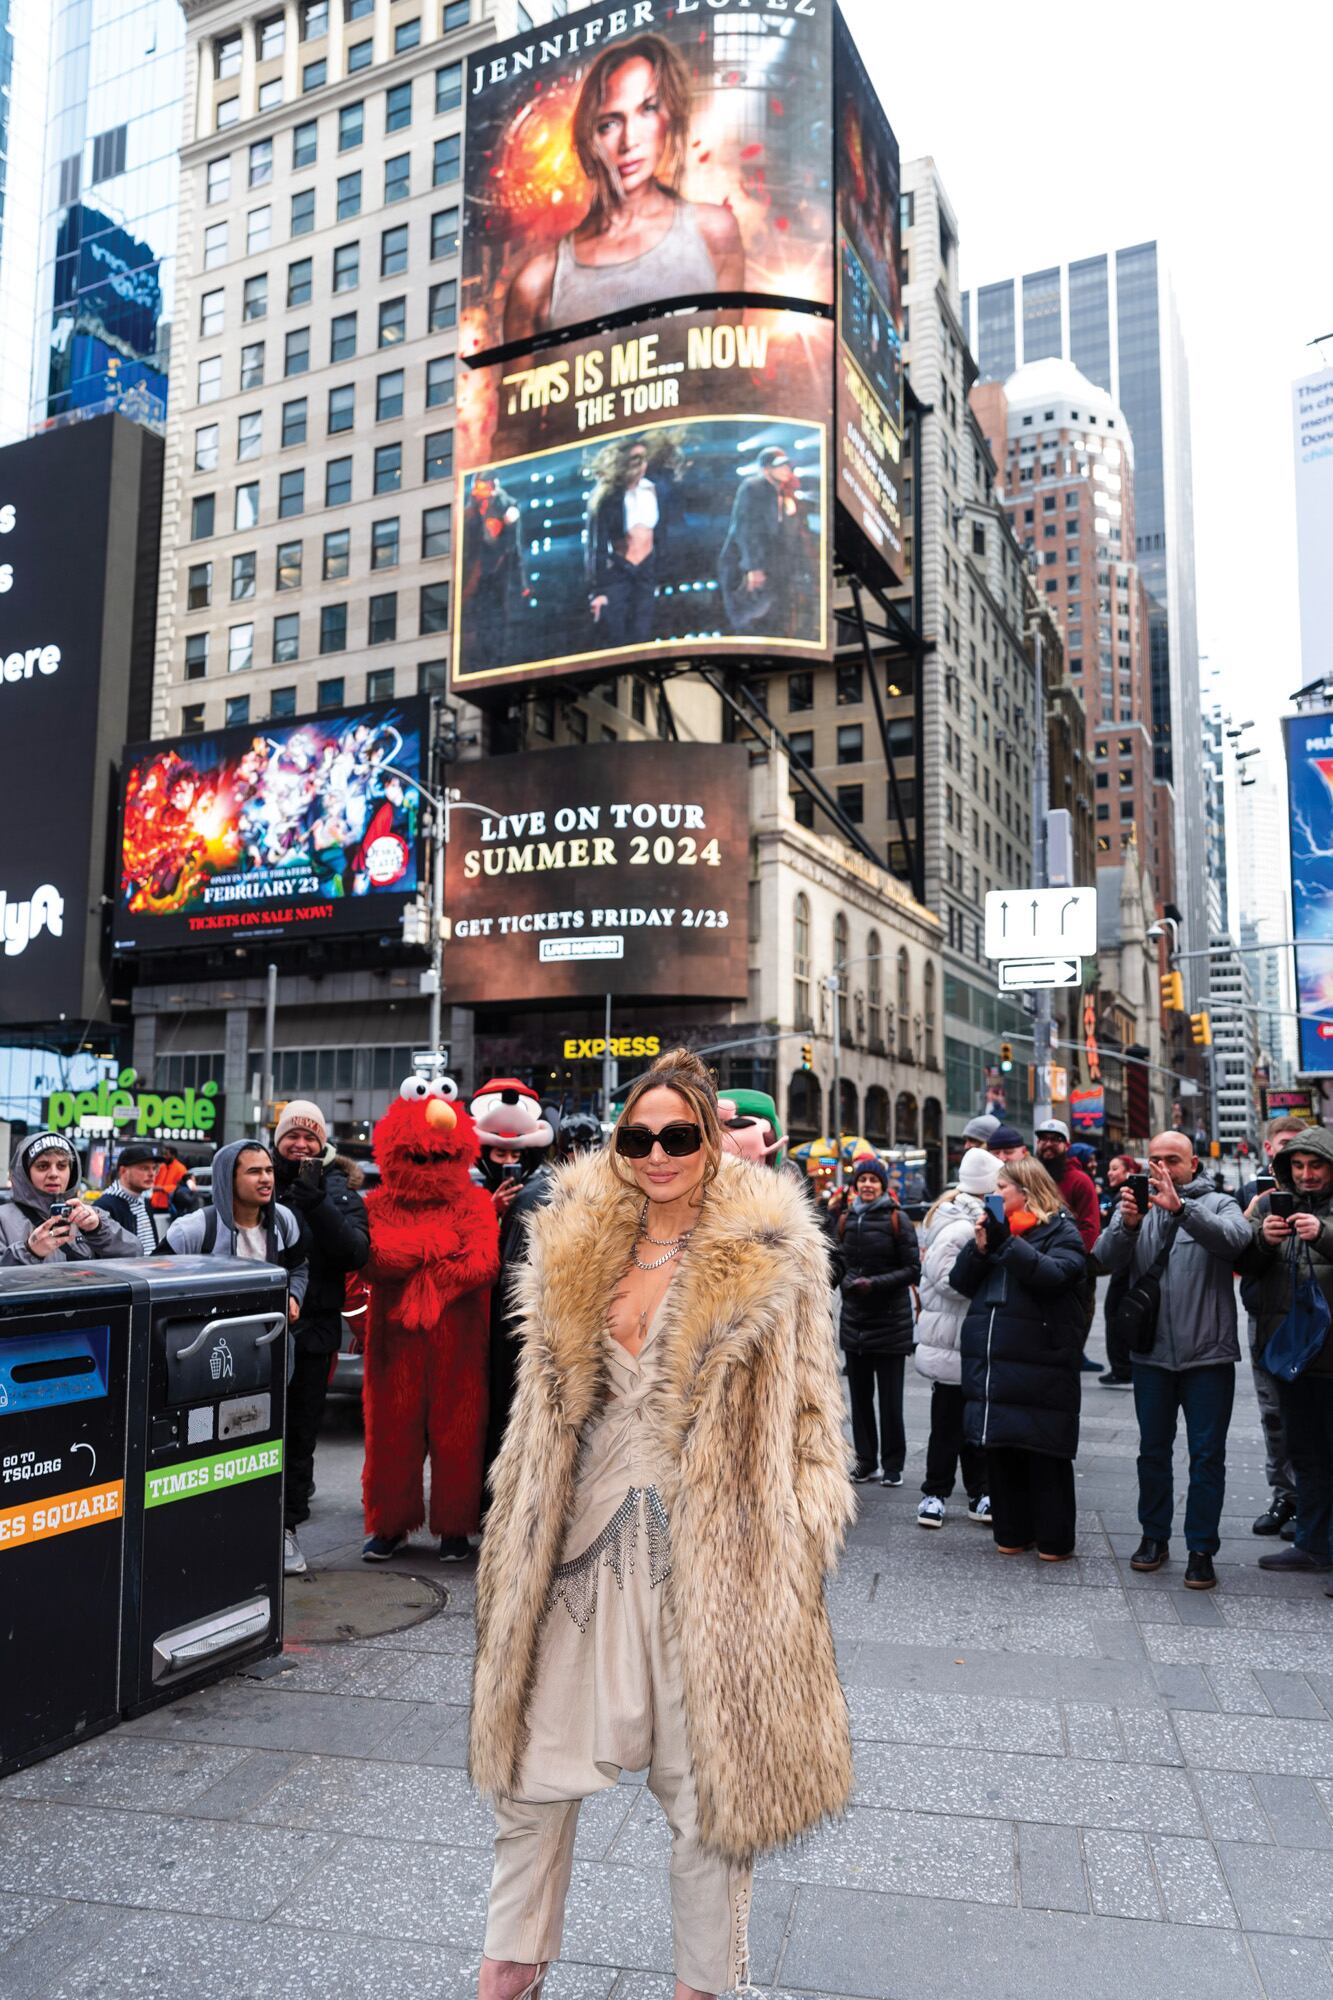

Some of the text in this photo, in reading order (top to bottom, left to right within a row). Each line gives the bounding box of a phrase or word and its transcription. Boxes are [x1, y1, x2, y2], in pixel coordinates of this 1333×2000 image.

[473, 2, 655, 95] JENNIFER
[502, 360, 570, 415] THIS
[574, 350, 604, 397] IS
[687, 325, 769, 370] NOW
[575, 378, 680, 432] THE TOUR
[0, 644, 61, 685] ere
[480, 803, 706, 841] LIVE ON TOUR
[463, 836, 722, 878] SUMMER 2024
[203, 876, 320, 903] FEBRUARY 23
[189, 914, 240, 930] TICKETS
[240, 911, 260, 926] ON
[261, 908, 293, 923] SALE
[455, 908, 729, 937] GET TICKETS FRIDAY 2/23
[564, 1037, 660, 1059] EXPRESS
[29, 1136, 70, 1158] GENIUS
[2, 1458, 62, 1483] TSQ.ORG
[3, 1451, 35, 1468] GO TO
[149, 1449, 279, 1499] TIMES SQUARE
[32, 1491, 119, 1533] SQUARE
